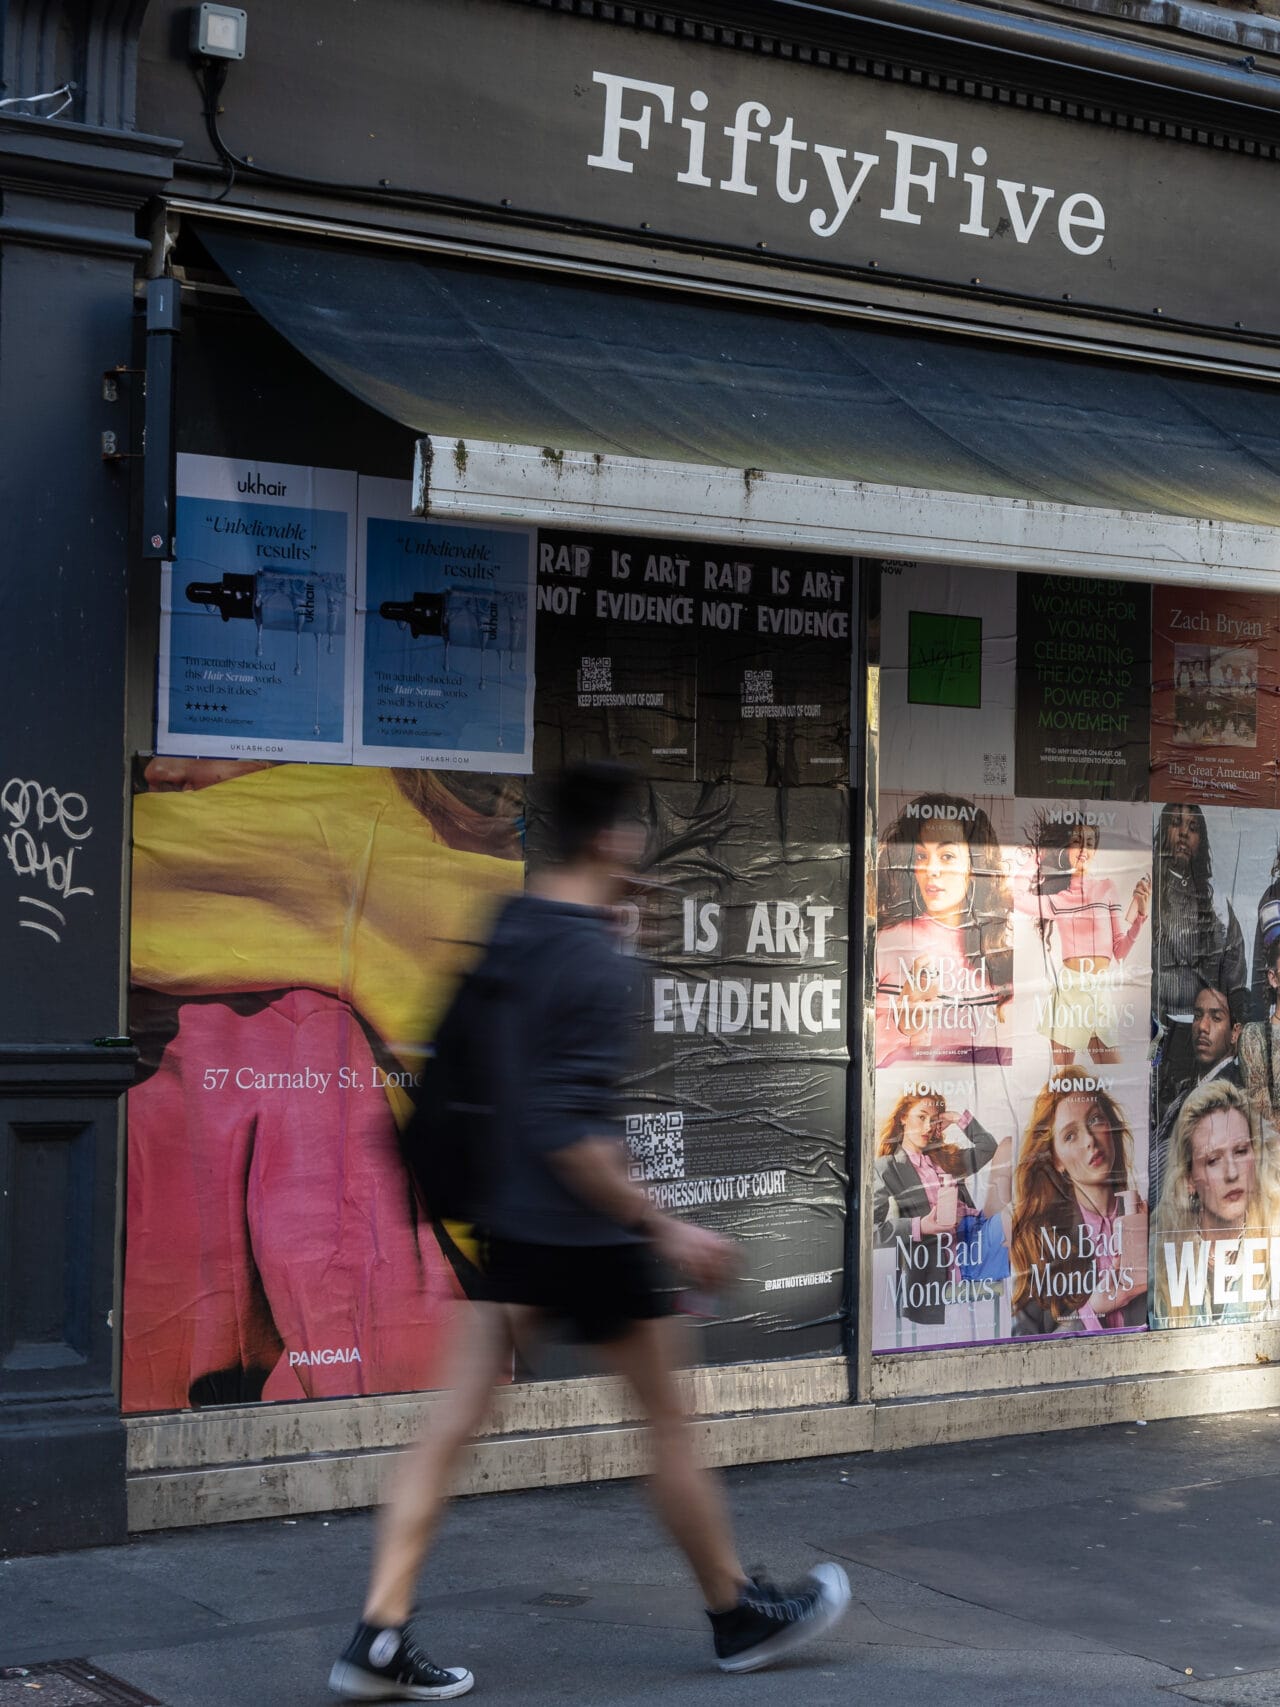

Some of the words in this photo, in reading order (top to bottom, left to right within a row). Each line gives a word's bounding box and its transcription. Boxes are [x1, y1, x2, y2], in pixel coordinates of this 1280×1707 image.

[586, 69, 1107, 257] FiftyFive
[238, 472, 288, 497] ukhair
[539, 542, 592, 578] RAP
[610, 549, 632, 580] IS
[644, 553, 691, 588] ART
[880, 566, 903, 576] NOW
[704, 560, 752, 594] RAP
[771, 565, 792, 596] IS
[802, 570, 846, 602] ART
[1042, 576, 1056, 590] A
[1057, 577, 1105, 595] GUIDE
[1108, 580, 1126, 596] BY
[298, 583, 315, 624] ukhair
[536, 584, 582, 616] NOT
[596, 588, 695, 625] EVIDENCE
[1107, 600, 1136, 621] FOR
[482, 602, 498, 640] ukhair
[702, 600, 745, 632] NOT
[756, 604, 850, 640] EVIDENCE
[1168, 608, 1211, 633] Zach
[1215, 613, 1263, 641] Bryan
[1034, 640, 1136, 665] CELEBRATING
[185, 669, 201, 680] this
[202, 670, 224, 681] Hair
[225, 672, 254, 683] Serum
[254, 674, 282, 684] works
[238, 660, 276, 672] shocked
[1034, 664, 1066, 682] THE
[1066, 666, 1094, 684] JOY
[1096, 668, 1133, 688] AND
[196, 684, 214, 694] well
[394, 684, 413, 694] Hair
[415, 686, 442, 697] Serum
[578, 694, 592, 707] KEEP
[592, 694, 626, 707] EXPRESSION
[626, 693, 638, 706] OUT
[638, 693, 646, 706] OF
[646, 692, 664, 706] COURT
[1044, 687, 1100, 708] POWER
[1102, 690, 1124, 710] OF
[742, 706, 754, 718] KEEP
[754, 705, 786, 718] EXPRESSION
[786, 705, 796, 717] OUT
[796, 704, 804, 717] OF
[804, 704, 822, 717] COURT
[1038, 709, 1130, 733] MOVEMENT
[230, 744, 284, 752] UKLASH.COM
[420, 755, 470, 764] UKLASH.COM
[1167, 762, 1185, 776] The
[1188, 763, 1215, 778] Great
[1216, 766, 1262, 780] American
[1191, 776, 1209, 789] Bar
[1210, 778, 1237, 791] Scene
[906, 804, 979, 822] MONDAY
[1048, 809, 1119, 827] MONDAY
[683, 898, 721, 955] IS
[746, 899, 834, 958] ART
[898, 955, 940, 994] No
[940, 956, 988, 992] Bad
[1079, 958, 1125, 992] Bad
[652, 975, 843, 1035] EVIDENCE
[885, 994, 999, 1038] Mondays
[1033, 994, 1136, 1038] Mondays
[203, 1068, 230, 1091] 57
[235, 1066, 332, 1094] Carnaby
[338, 1066, 365, 1093] St,
[903, 1080, 977, 1097] MONDAY
[1048, 1077, 1114, 1094] MONDAY
[647, 1179, 712, 1210] EXPRESSION
[713, 1178, 735, 1200] OUT
[736, 1174, 752, 1198] OF
[752, 1169, 787, 1196] COURT
[894, 1234, 930, 1272] No
[936, 1231, 984, 1268] Bad
[1040, 1224, 1072, 1261] No
[1077, 1222, 1124, 1260] Bad
[764, 1270, 833, 1292] @ARTNOTEVIDENCE
[886, 1268, 995, 1312] Mondays
[1028, 1261, 1135, 1301] Mondays
[289, 1347, 362, 1367] PANGAIA
